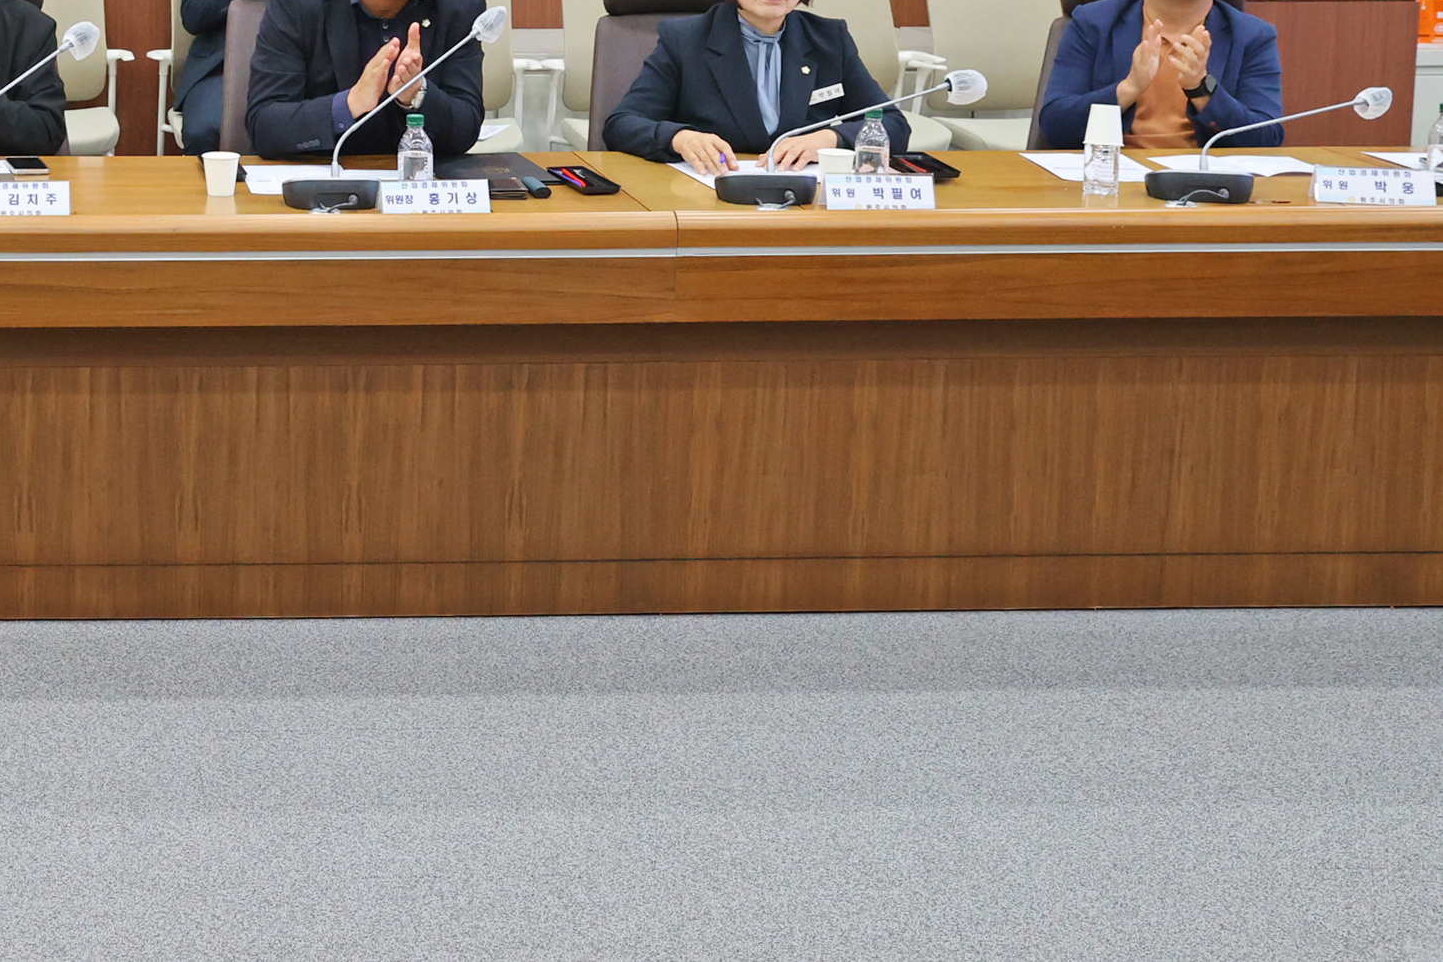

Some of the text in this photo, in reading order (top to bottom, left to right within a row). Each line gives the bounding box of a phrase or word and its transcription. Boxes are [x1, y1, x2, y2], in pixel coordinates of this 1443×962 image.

[1338, 169, 1412, 178] 산업경제위원회
[401, 181, 468, 189] 산업경제위원회
[1323, 180, 1348, 190] 위원
[8, 193, 57, 205] 김치주
[385, 192, 477, 205] 위원장 홍기상
[832, 187, 921, 200] 위원 박필여
